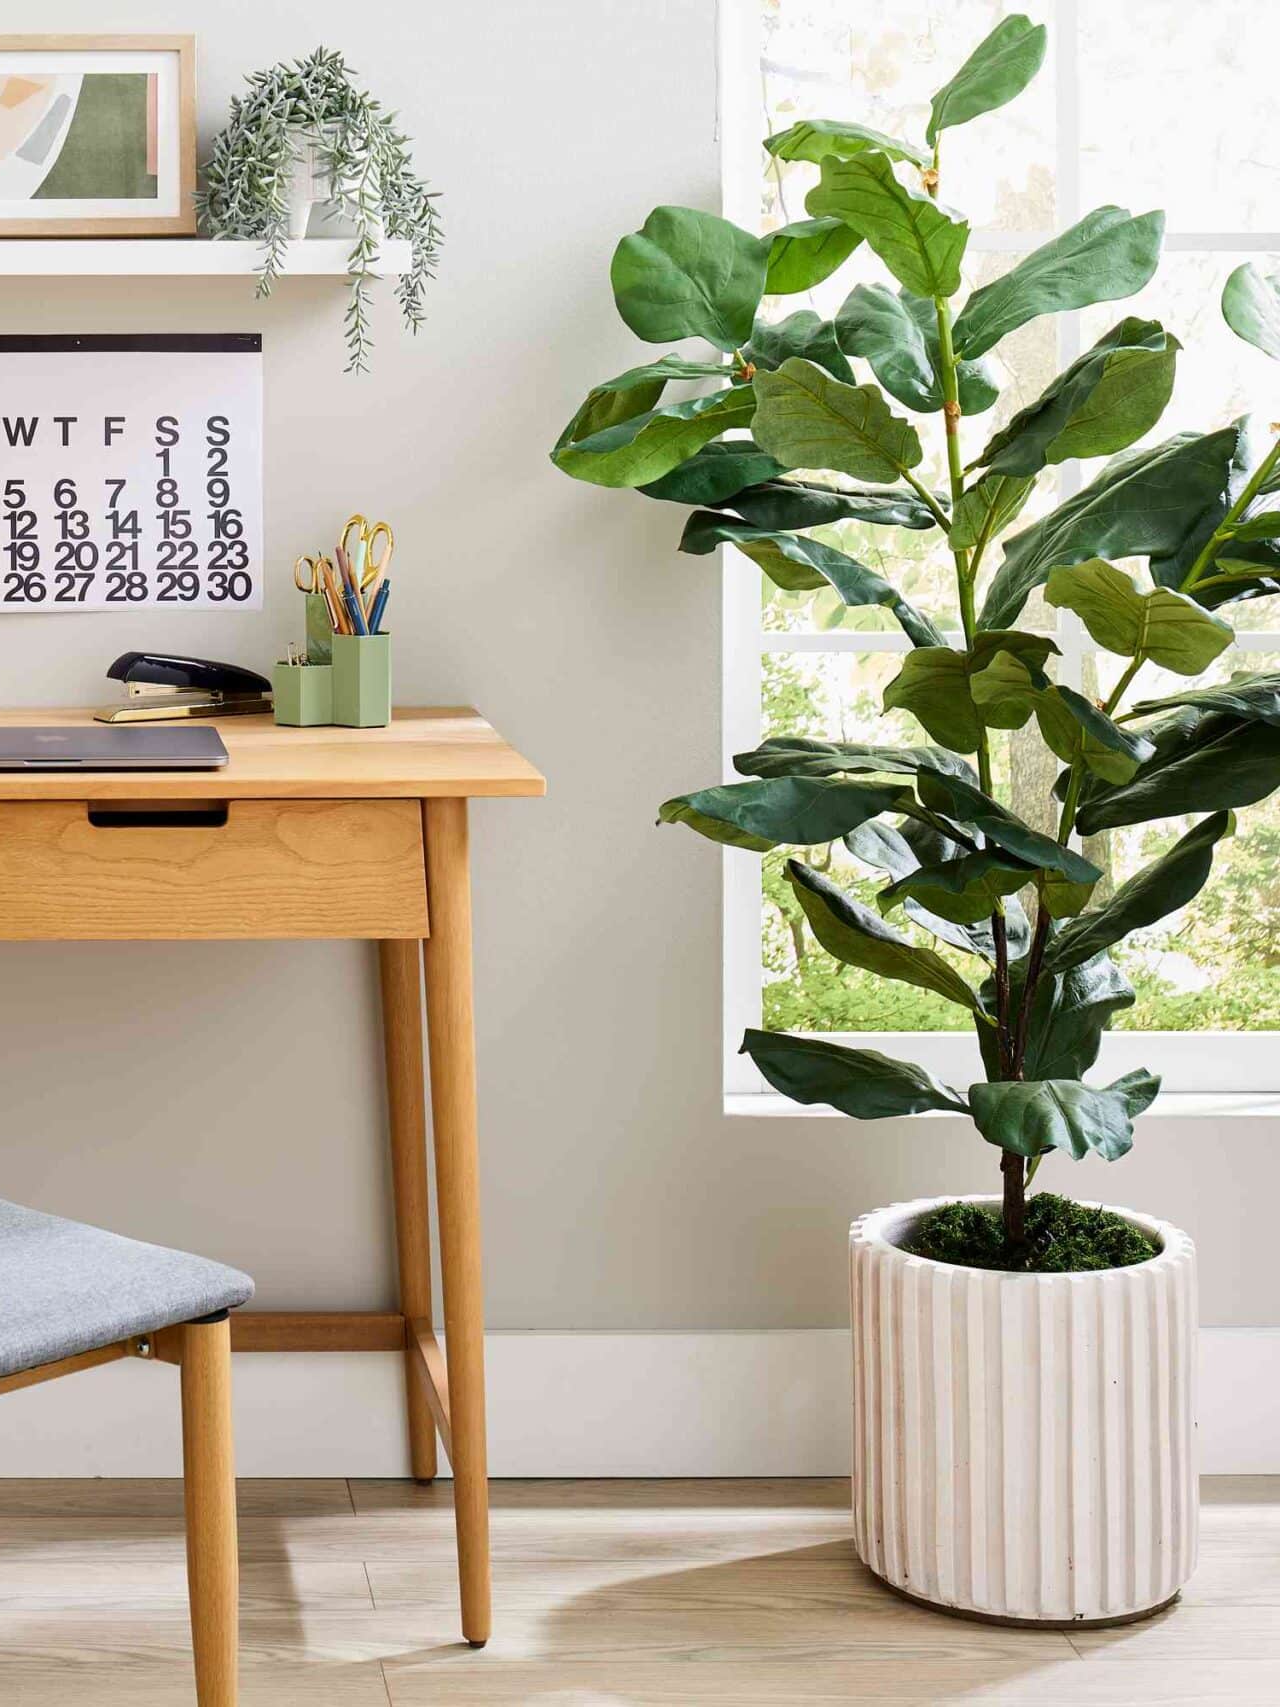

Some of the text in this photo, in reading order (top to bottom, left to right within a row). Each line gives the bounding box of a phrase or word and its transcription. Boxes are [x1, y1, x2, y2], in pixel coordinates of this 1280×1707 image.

[3, 417, 38, 446] W
[54, 417, 77, 446] T
[105, 417, 125, 446] F
[156, 416, 179, 446] S
[207, 416, 230, 446] S
[156, 448, 228, 476] 1 2
[3, 480, 25, 508] 5
[54, 479, 77, 509] 6
[105, 480, 126, 508] 7
[156, 479, 178, 508] 8
[207, 478, 229, 508] 9
[3, 511, 37, 539] 12
[54, 510, 89, 539] 13
[106, 511, 142, 539] 14
[156, 510, 191, 539] 15
[207, 509, 243, 539] 16
[3, 542, 39, 571] 19
[55, 541, 98, 571] 20
[106, 542, 138, 570] 21
[157, 541, 198, 570] 22
[208, 540, 249, 570] 23
[4, 573, 46, 602] 26
[55, 573, 95, 601] 27
[106, 572, 148, 601] 28
[157, 572, 200, 601] 29
[207, 571, 252, 601] 30
